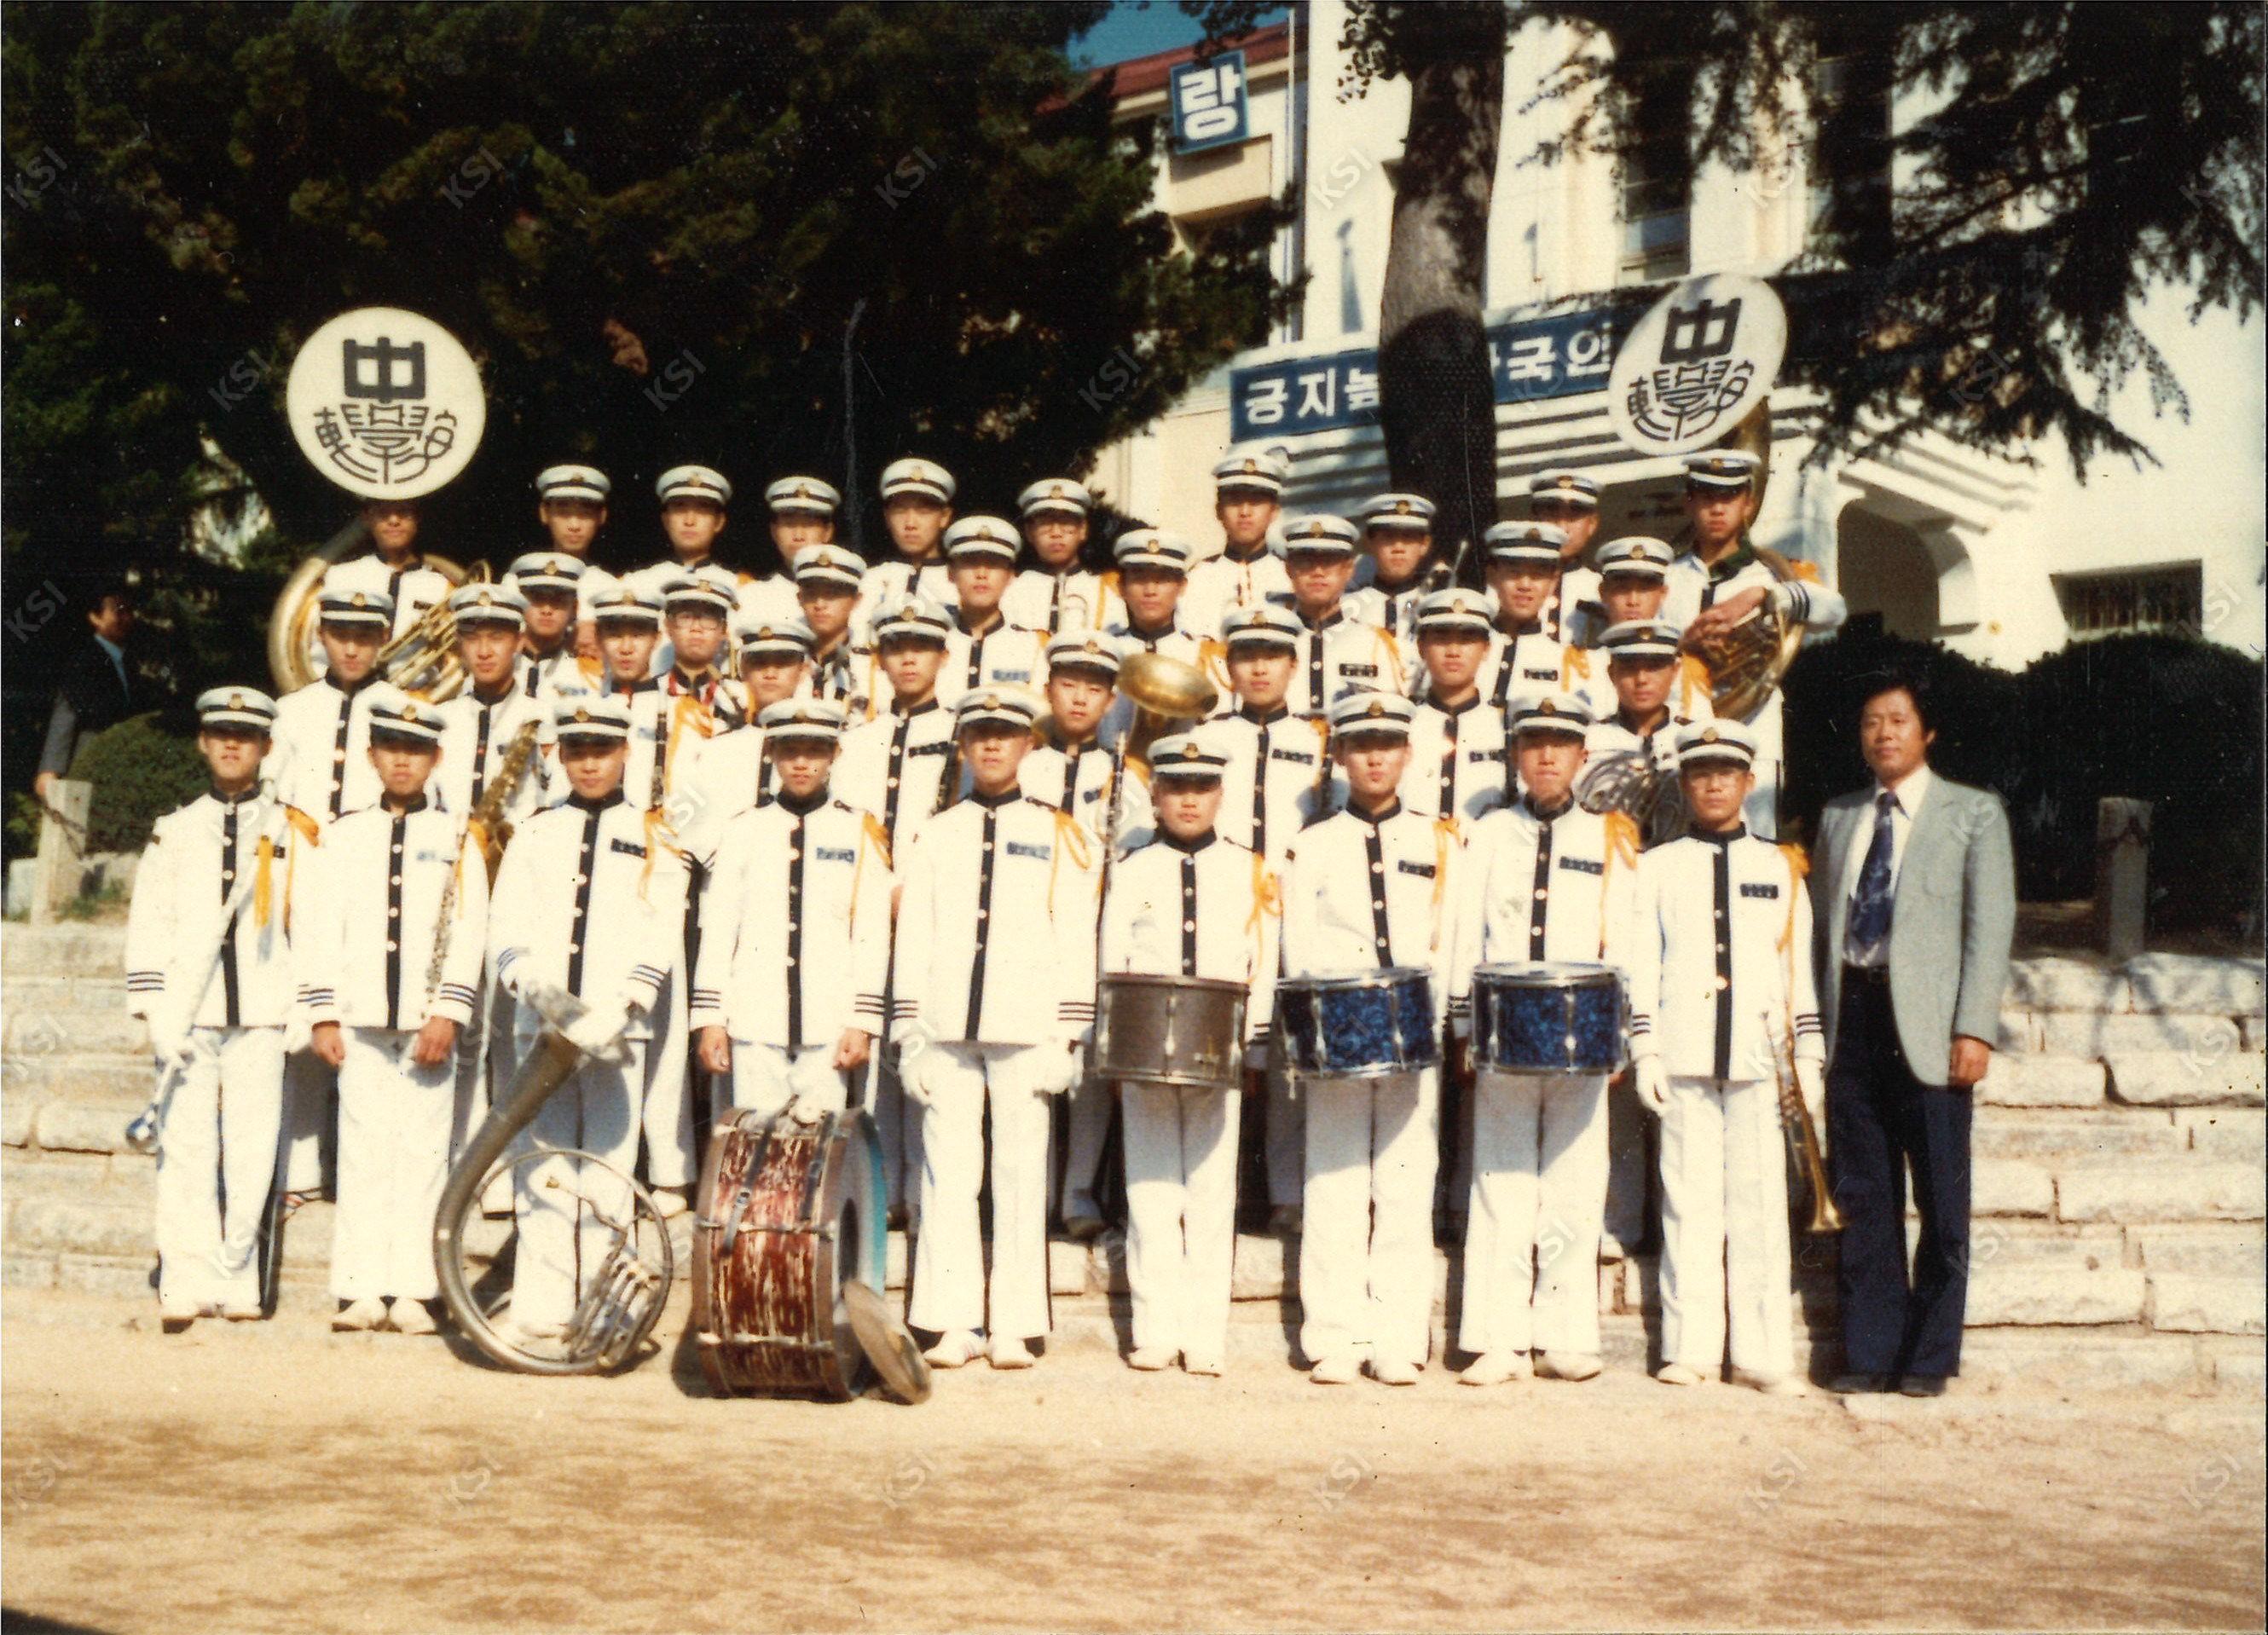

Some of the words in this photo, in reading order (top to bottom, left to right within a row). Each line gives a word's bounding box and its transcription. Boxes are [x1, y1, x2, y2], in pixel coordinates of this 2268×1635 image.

[1178, 64, 1241, 141] 랑
[1490, 322, 1611, 381] 국인
[1660, 298, 1742, 365] 中
[343, 337, 426, 404] 中
